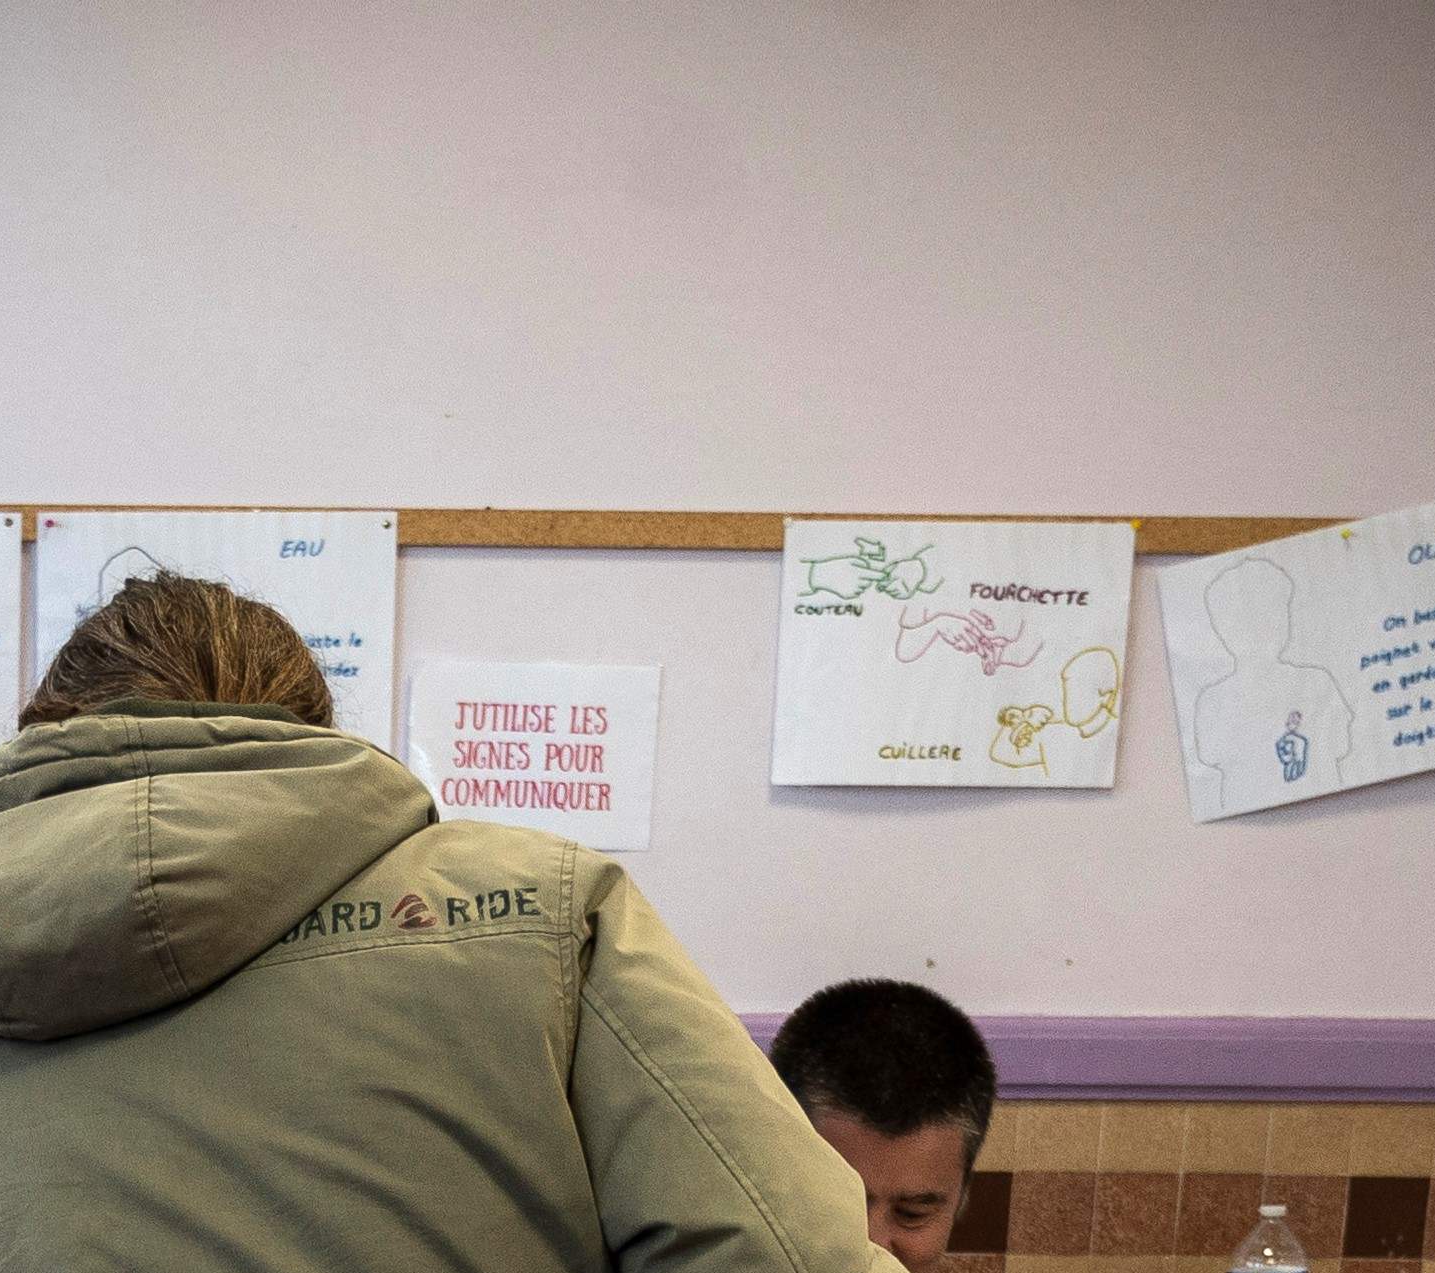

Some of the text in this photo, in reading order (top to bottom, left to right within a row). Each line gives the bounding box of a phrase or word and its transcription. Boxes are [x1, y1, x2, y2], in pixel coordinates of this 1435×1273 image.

[279, 538, 325, 559] EAU
[970, 582, 1089, 607] FOURCHETTE
[570, 706, 608, 736] LES
[453, 740, 604, 773] SIGNES POUR
[441, 778, 612, 813] COMMUNIQUER
[282, 887, 542, 944] ARD RIDE
